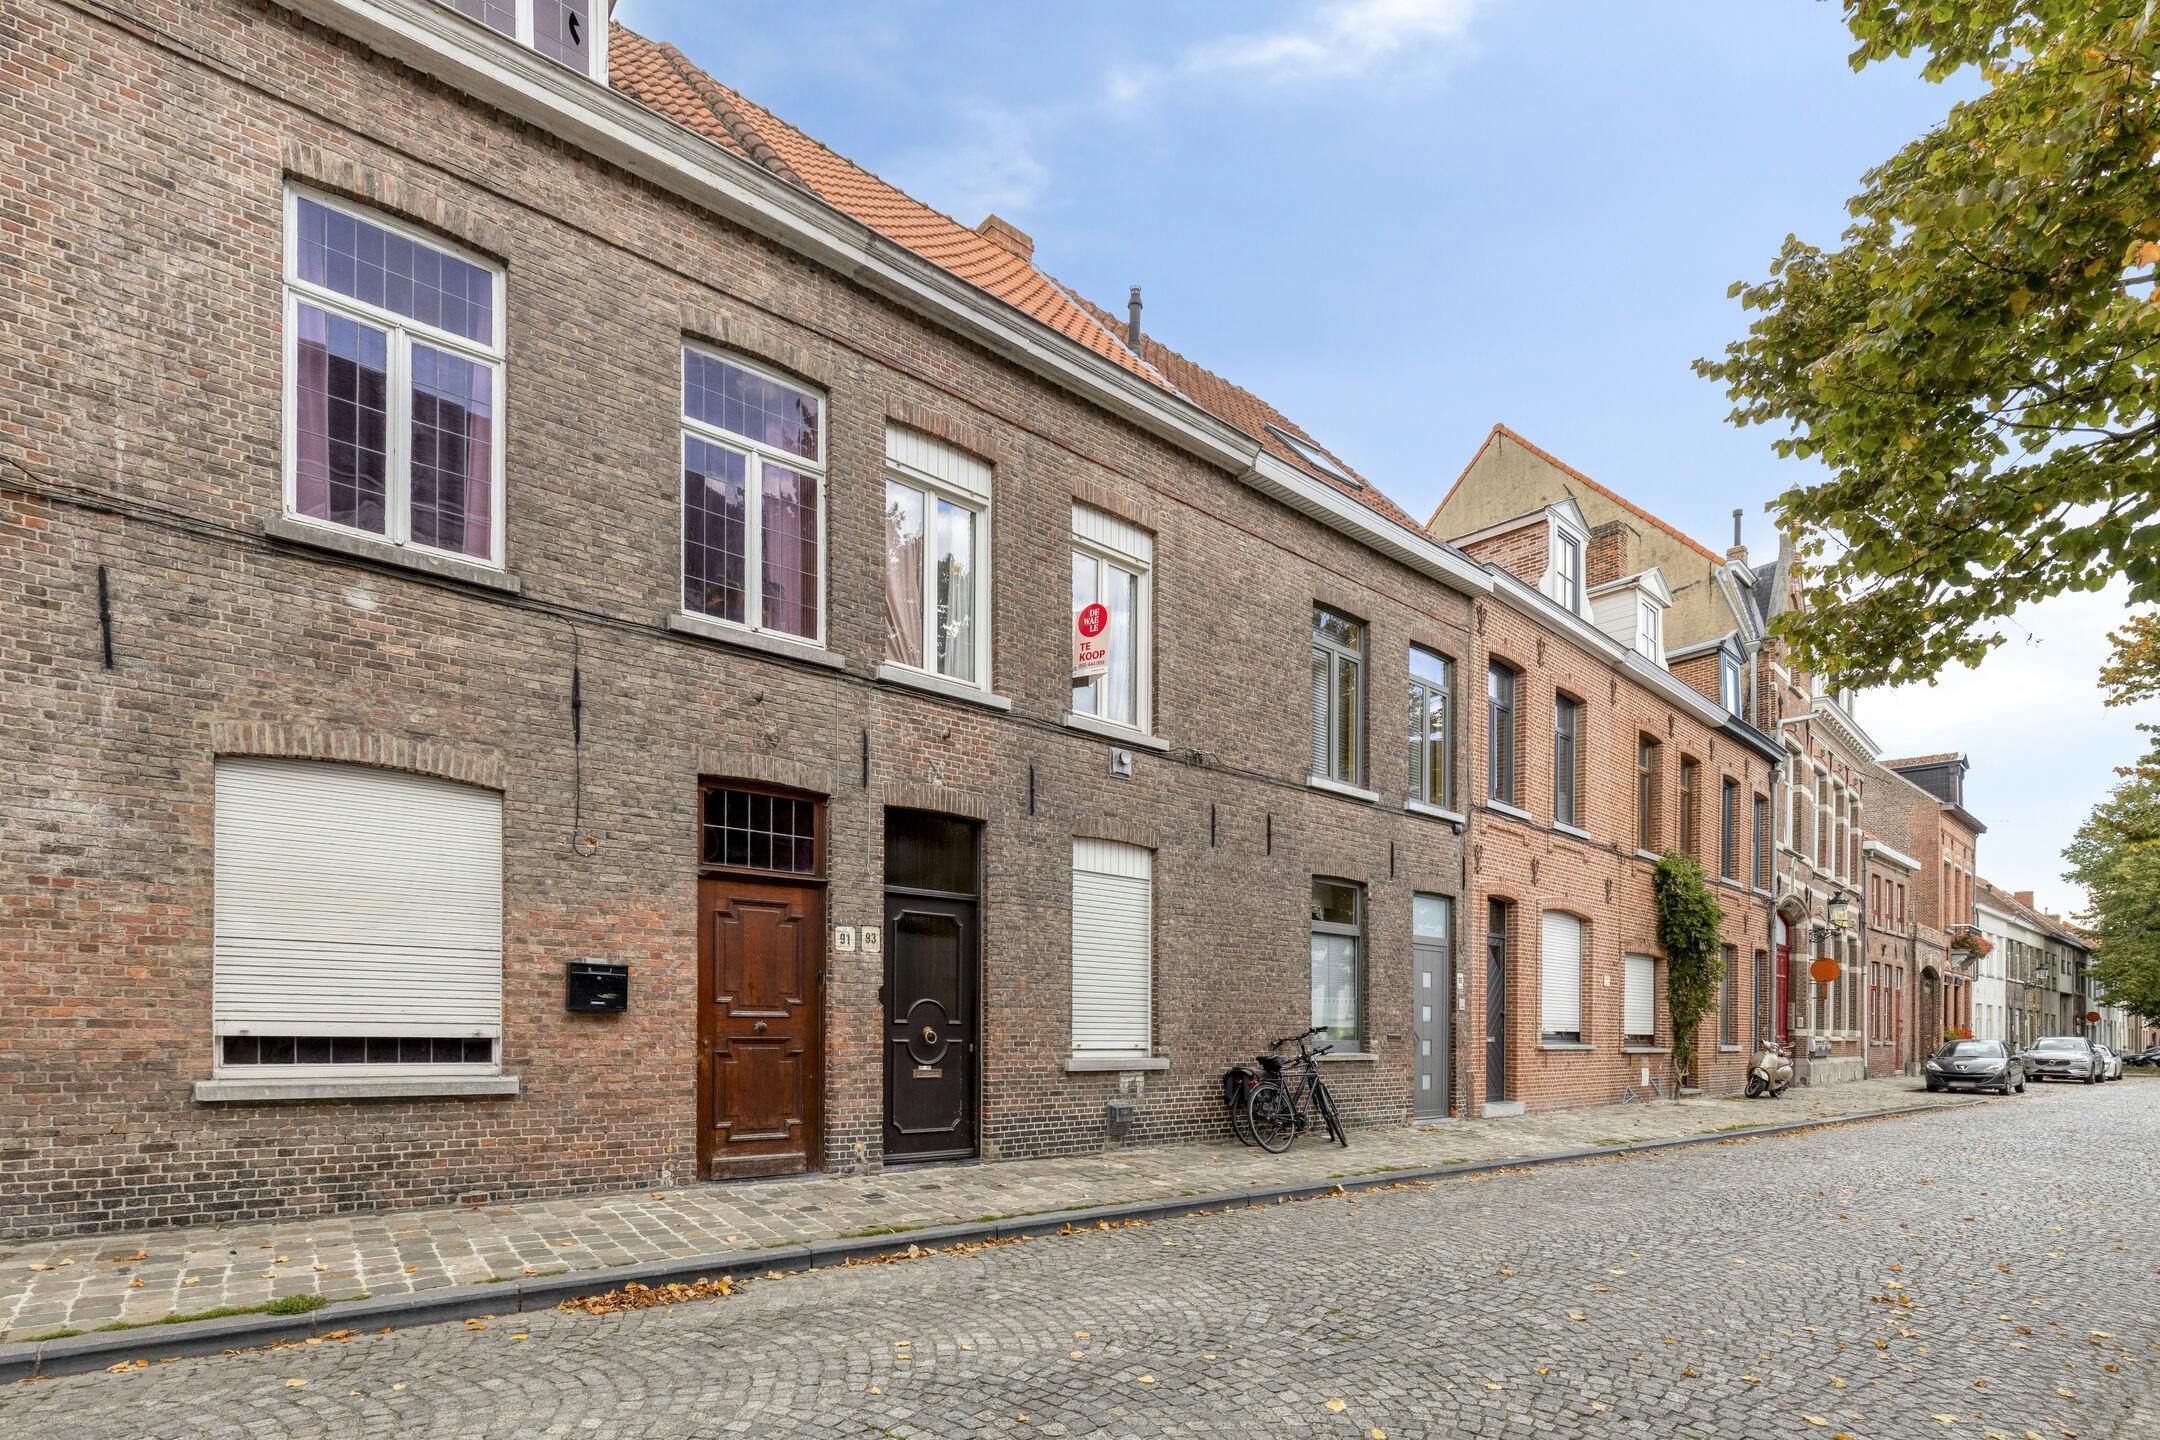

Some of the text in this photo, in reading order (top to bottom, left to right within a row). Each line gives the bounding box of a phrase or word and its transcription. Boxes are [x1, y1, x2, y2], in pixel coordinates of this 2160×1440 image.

[1089, 608, 1100, 617] DE
[1084, 616, 1099, 625] WAE
[1089, 624, 1098, 632] LE
[1080, 642, 1091, 651] TE
[1079, 650, 1105, 661] KOOP
[840, 933, 850, 945] 91
[865, 932, 877, 944] 93
